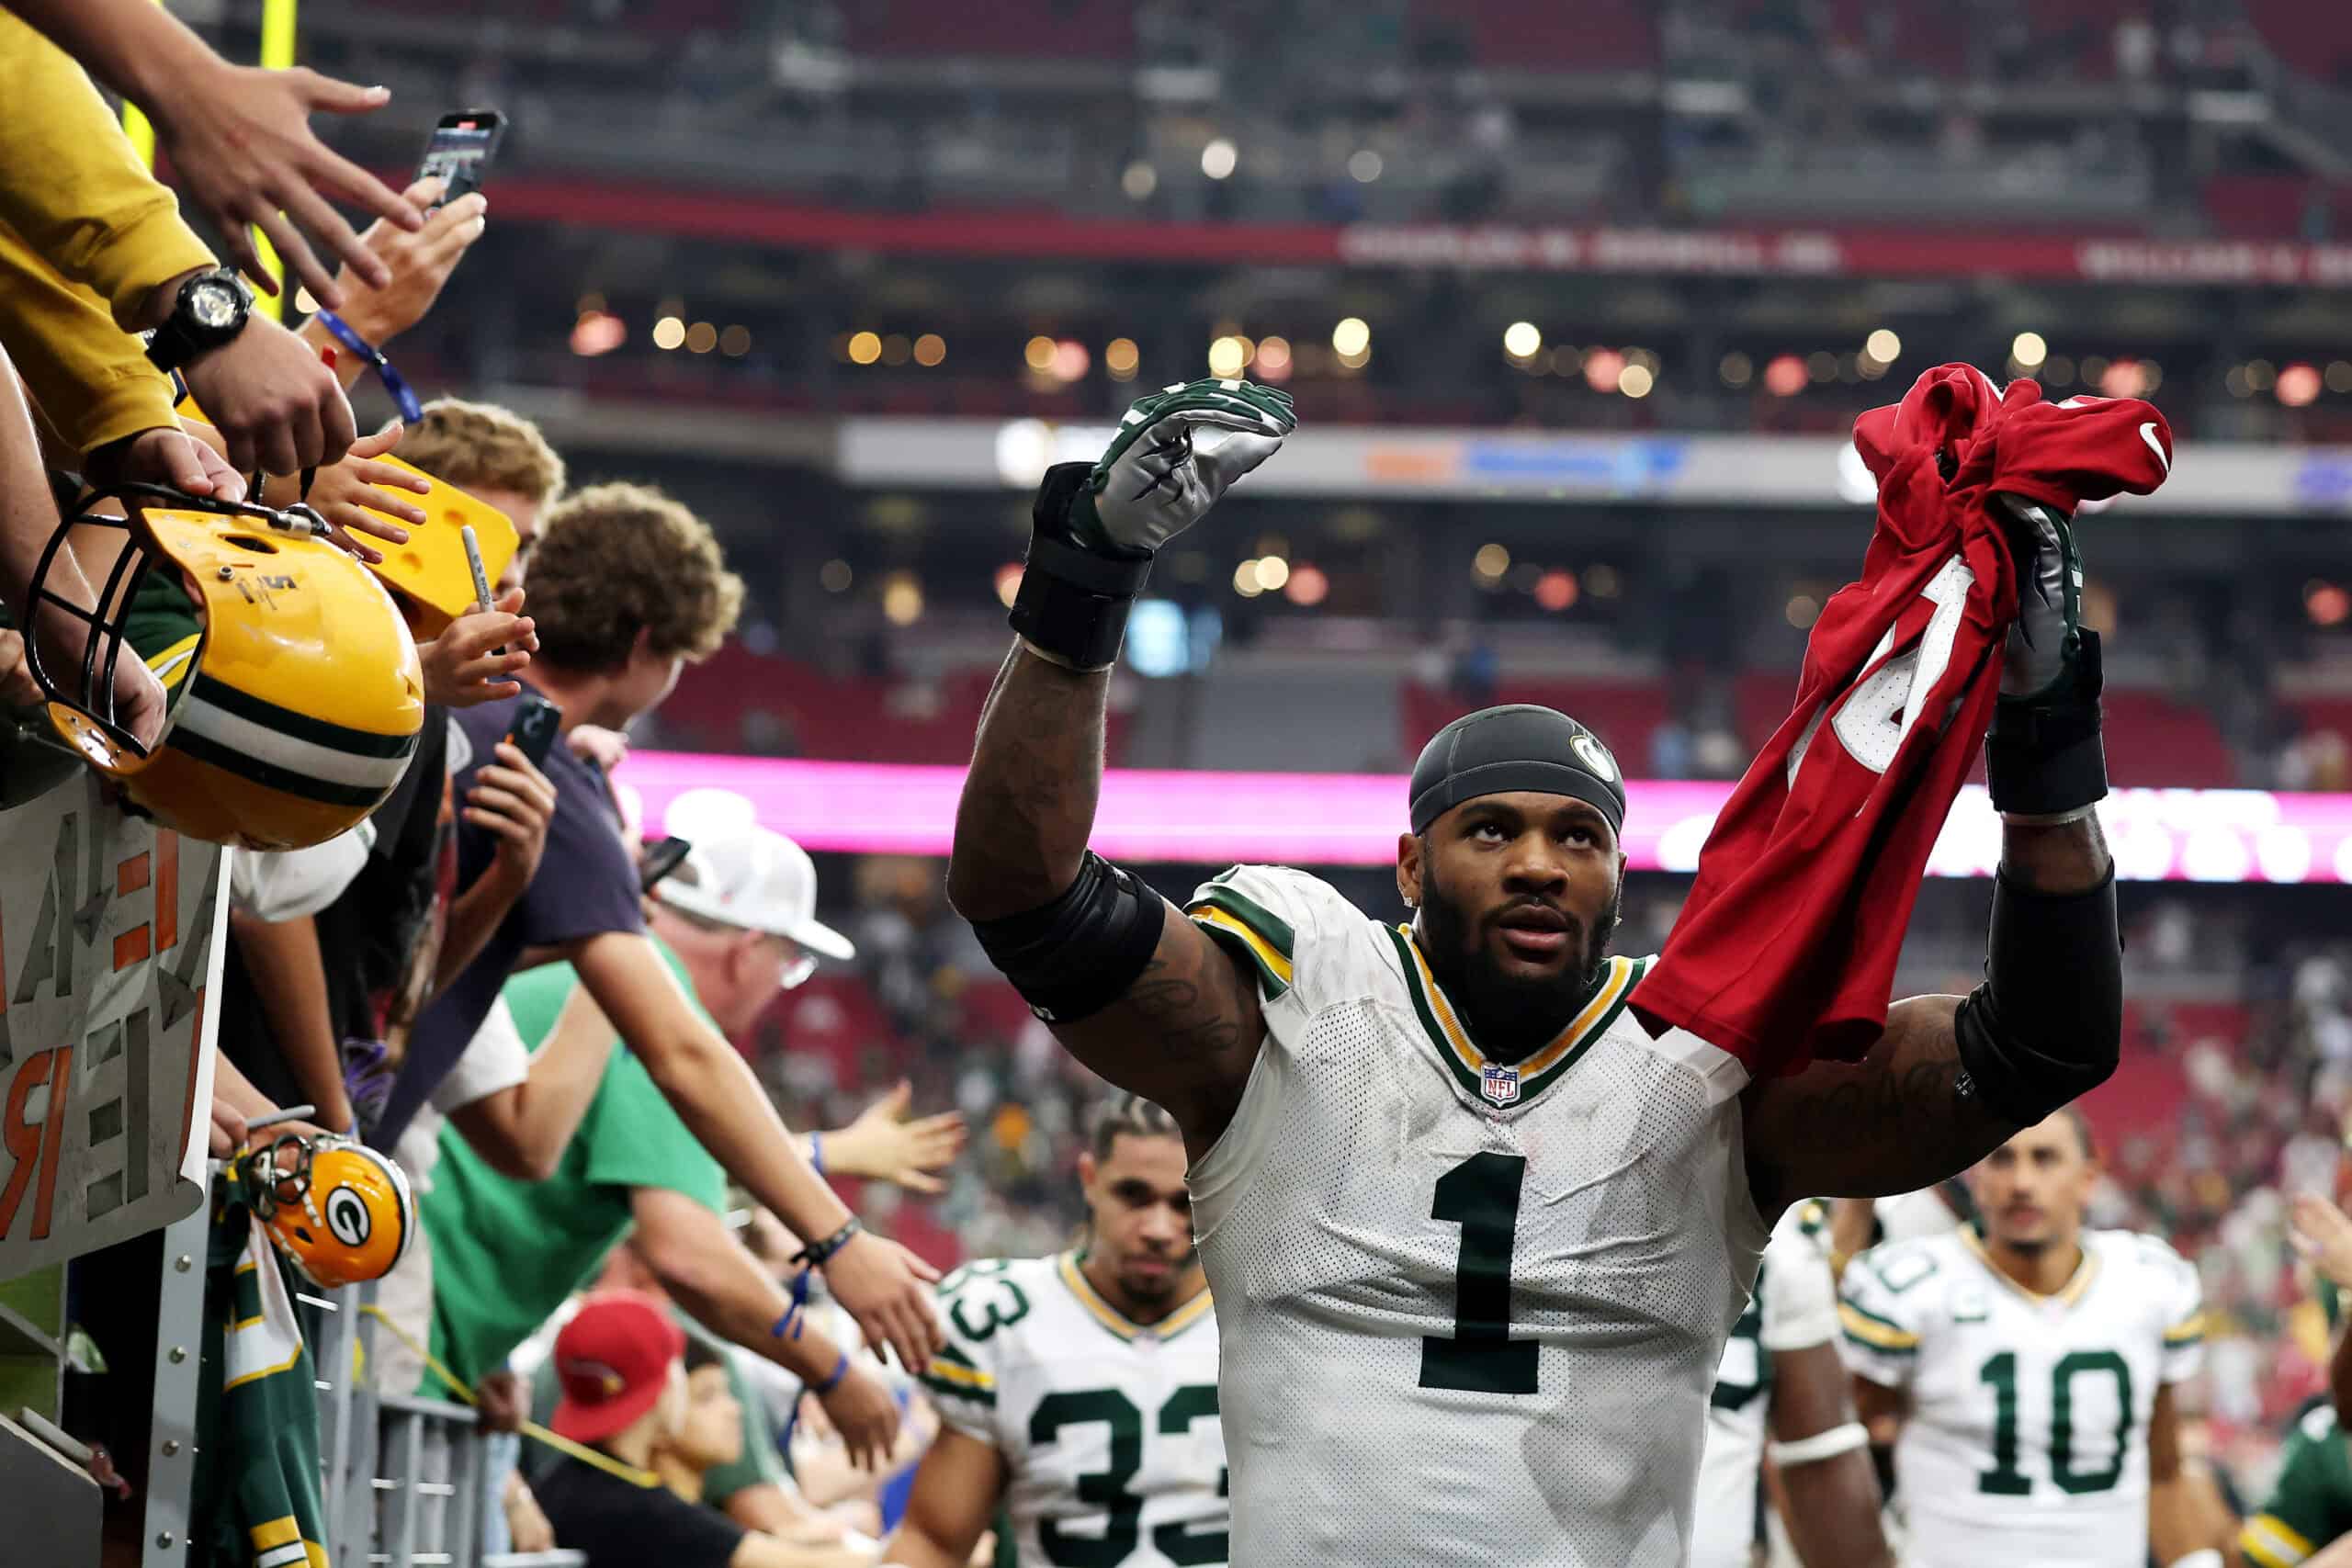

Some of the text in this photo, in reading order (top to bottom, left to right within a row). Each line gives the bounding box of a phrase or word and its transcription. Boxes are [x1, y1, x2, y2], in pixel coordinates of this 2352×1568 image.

[1486, 1077, 1515, 1099] NFL
[325, 1186, 371, 1247] G
[1418, 1150, 1541, 1394] 1
[1029, 1386, 1229, 1568] 33
[1979, 1348, 2132, 1495] 10
